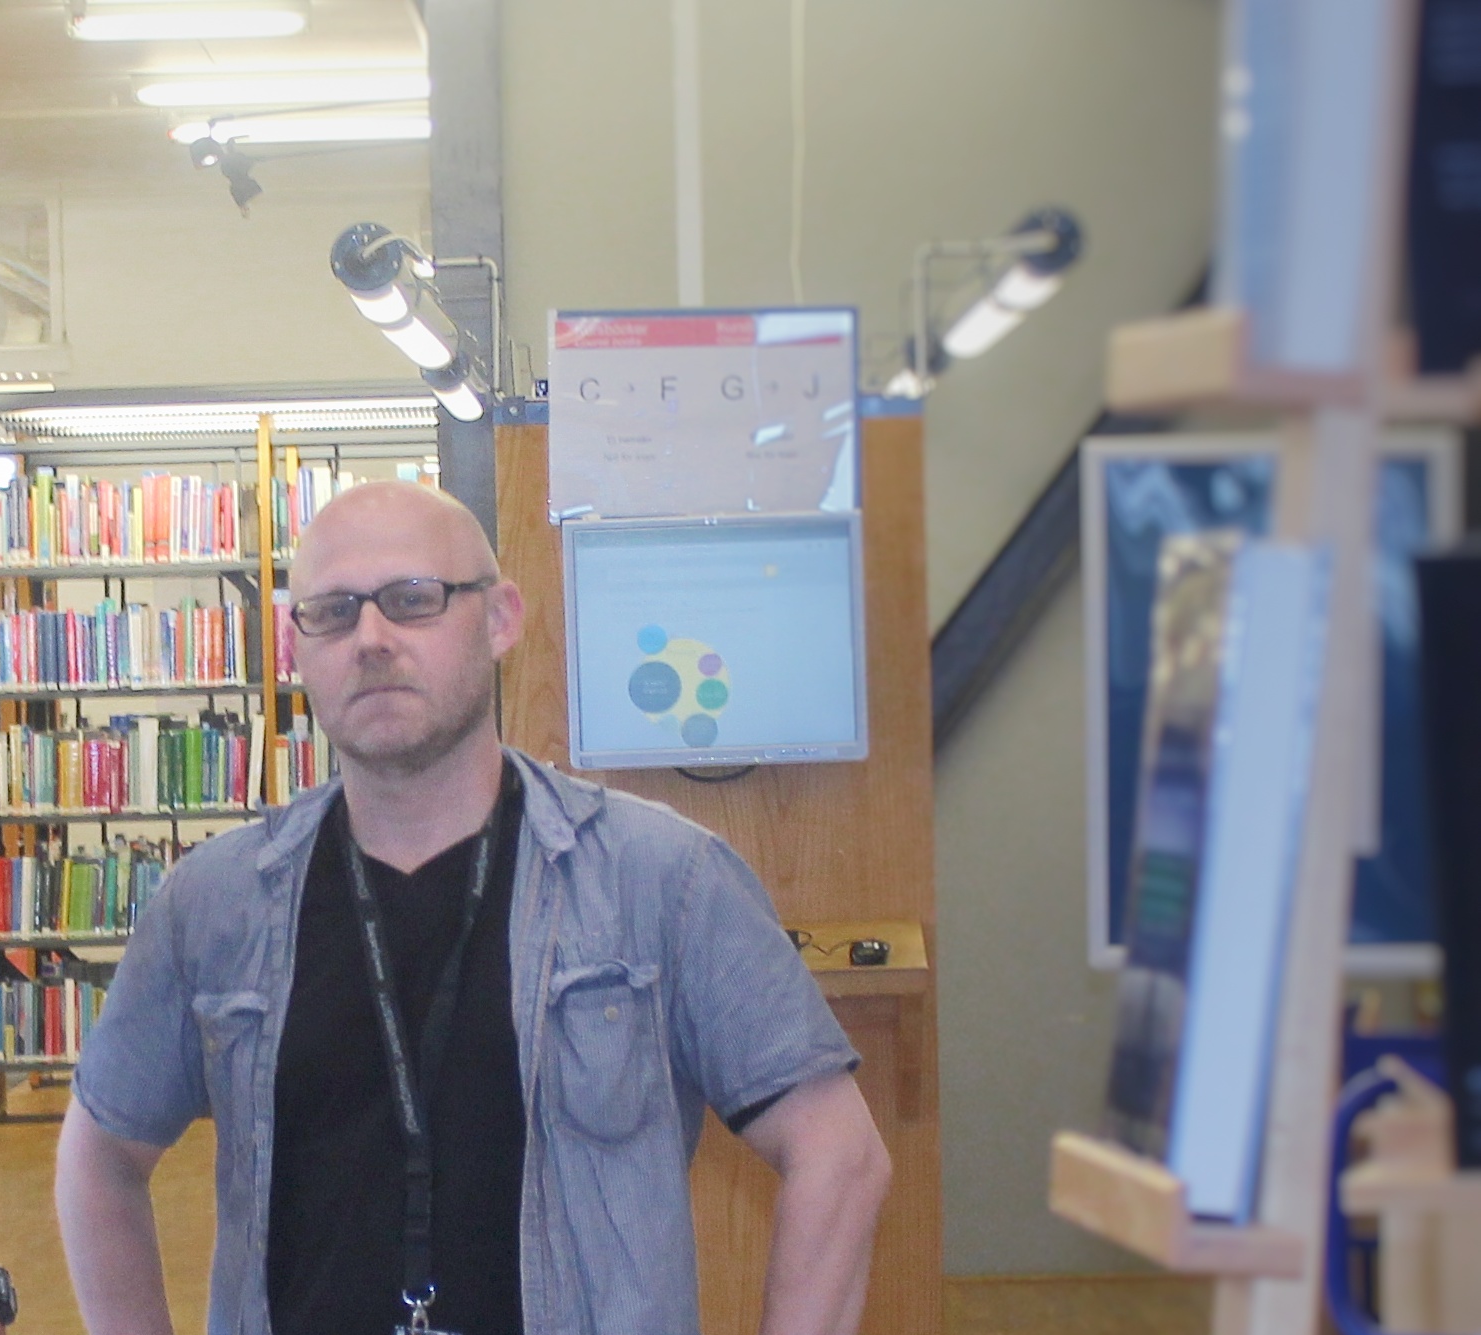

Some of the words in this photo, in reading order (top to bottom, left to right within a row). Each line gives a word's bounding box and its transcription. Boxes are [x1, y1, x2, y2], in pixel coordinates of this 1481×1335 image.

[579, 377, 601, 402] C
[661, 376, 679, 401] F
[721, 374, 745, 401] G
[802, 369, 820, 401] J
